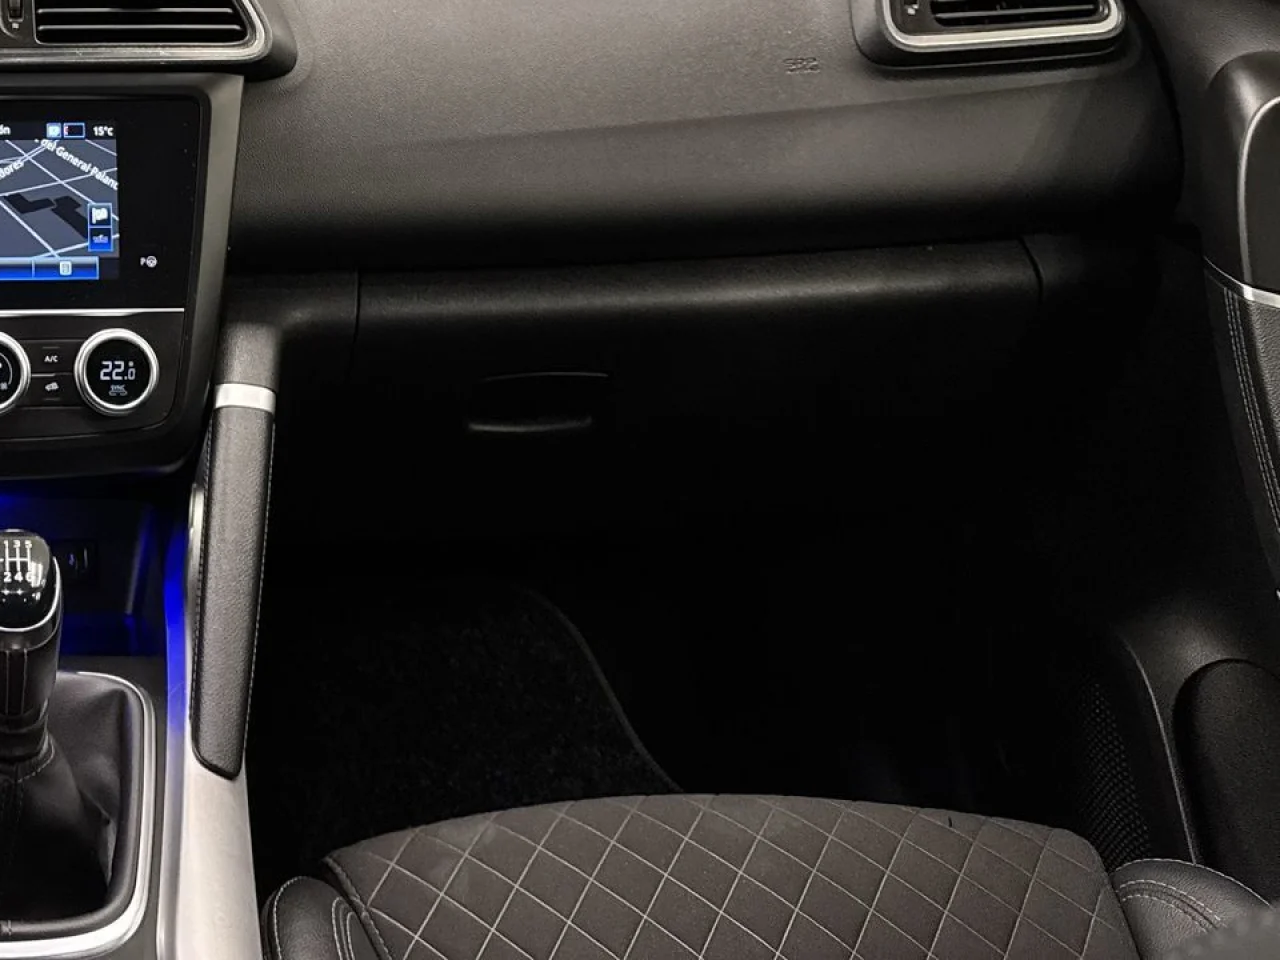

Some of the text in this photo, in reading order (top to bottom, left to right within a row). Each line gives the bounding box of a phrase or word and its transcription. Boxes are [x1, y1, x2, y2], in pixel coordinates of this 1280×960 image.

[93, 126, 114, 137] 15°C
[55, 146, 92, 173] General
[44, 355, 59, 363] A/C
[13, 539, 21, 549] 3
[24, 539, 33, 549] 5
[3, 571, 12, 583] 2
[14, 571, 24, 583] 4
